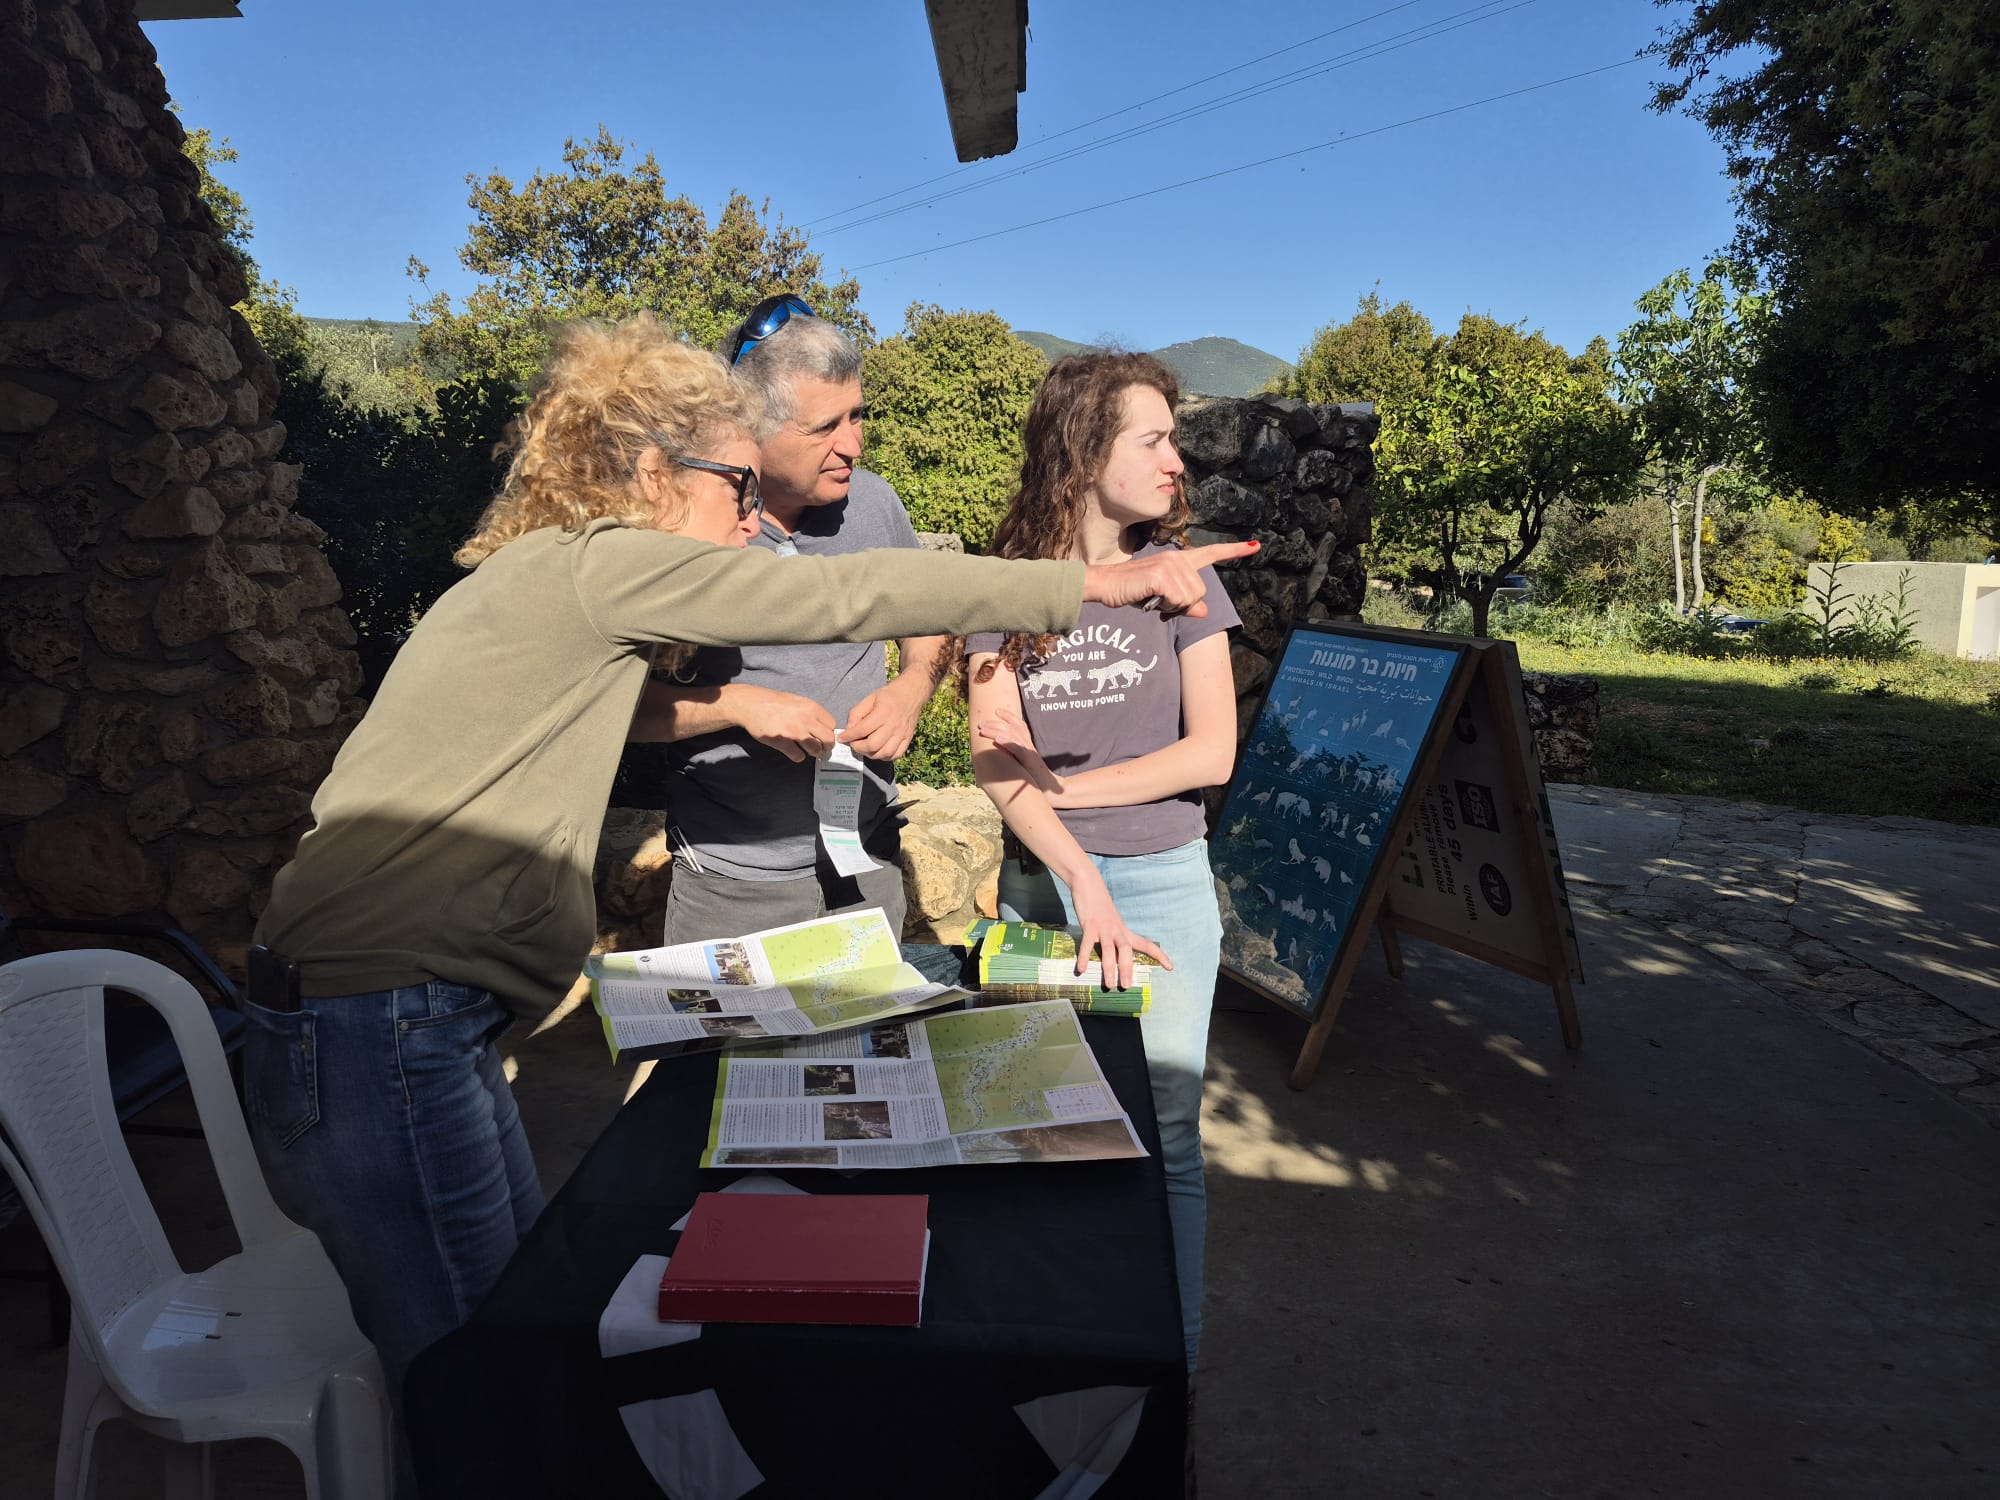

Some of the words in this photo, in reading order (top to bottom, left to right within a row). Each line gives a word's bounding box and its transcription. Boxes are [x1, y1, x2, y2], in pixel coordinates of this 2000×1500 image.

[1043, 624, 1141, 661] AGICAL.
[1062, 652, 1084, 662] YOU
[1088, 650, 1106, 661] ARE
[1284, 665, 1316, 678] PROTECTED
[1318, 671, 1333, 680] WILD
[1309, 649, 1357, 671] מוגנות
[1360, 657, 1379, 676] בר
[1381, 660, 1418, 682] חיות
[1286, 676, 1314, 687] ANIMALS
[1315, 680, 1324, 688] IN
[1325, 682, 1351, 694] ISRAEL
[1040, 701, 1067, 712] KNOW
[1069, 699, 1094, 709] YOUR
[1095, 693, 1126, 706] POWER
[1438, 784, 1457, 831] days
[1467, 785, 1489, 829] ISO
[1429, 804, 1446, 850] remove
[1425, 835, 1447, 894] PRINTABLE
[1448, 838, 1463, 863] 45
[1440, 857, 1456, 895] Please
[1487, 874, 1505, 906] IAF
[1463, 884, 1478, 921] Within
